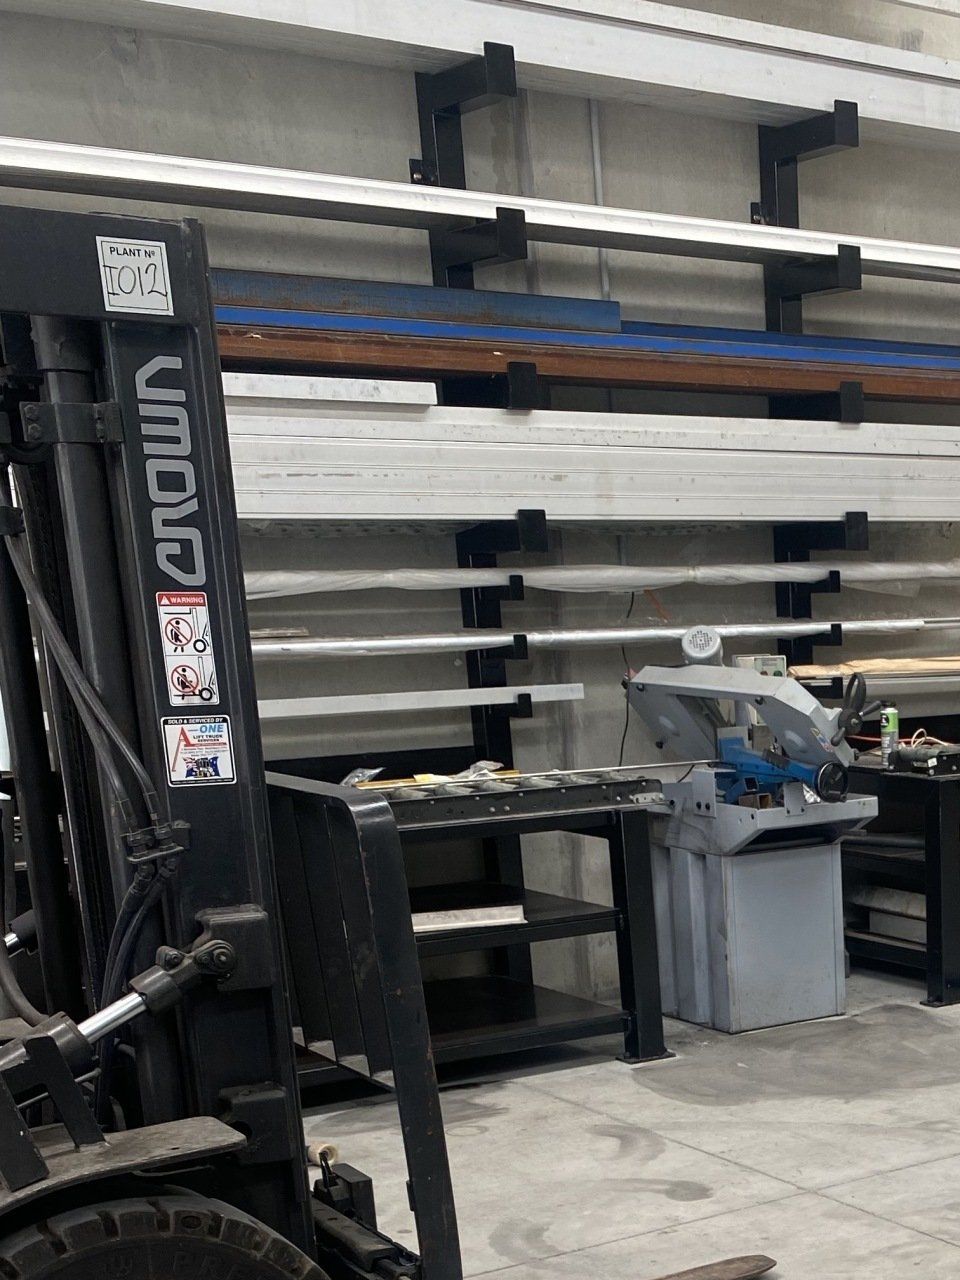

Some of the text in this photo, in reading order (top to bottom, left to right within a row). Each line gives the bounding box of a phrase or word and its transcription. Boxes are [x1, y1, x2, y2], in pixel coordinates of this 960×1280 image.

[109, 246, 141, 258] PLANT
[135, 355, 207, 587] CROWN
[169, 596, 204, 604] WARNING
